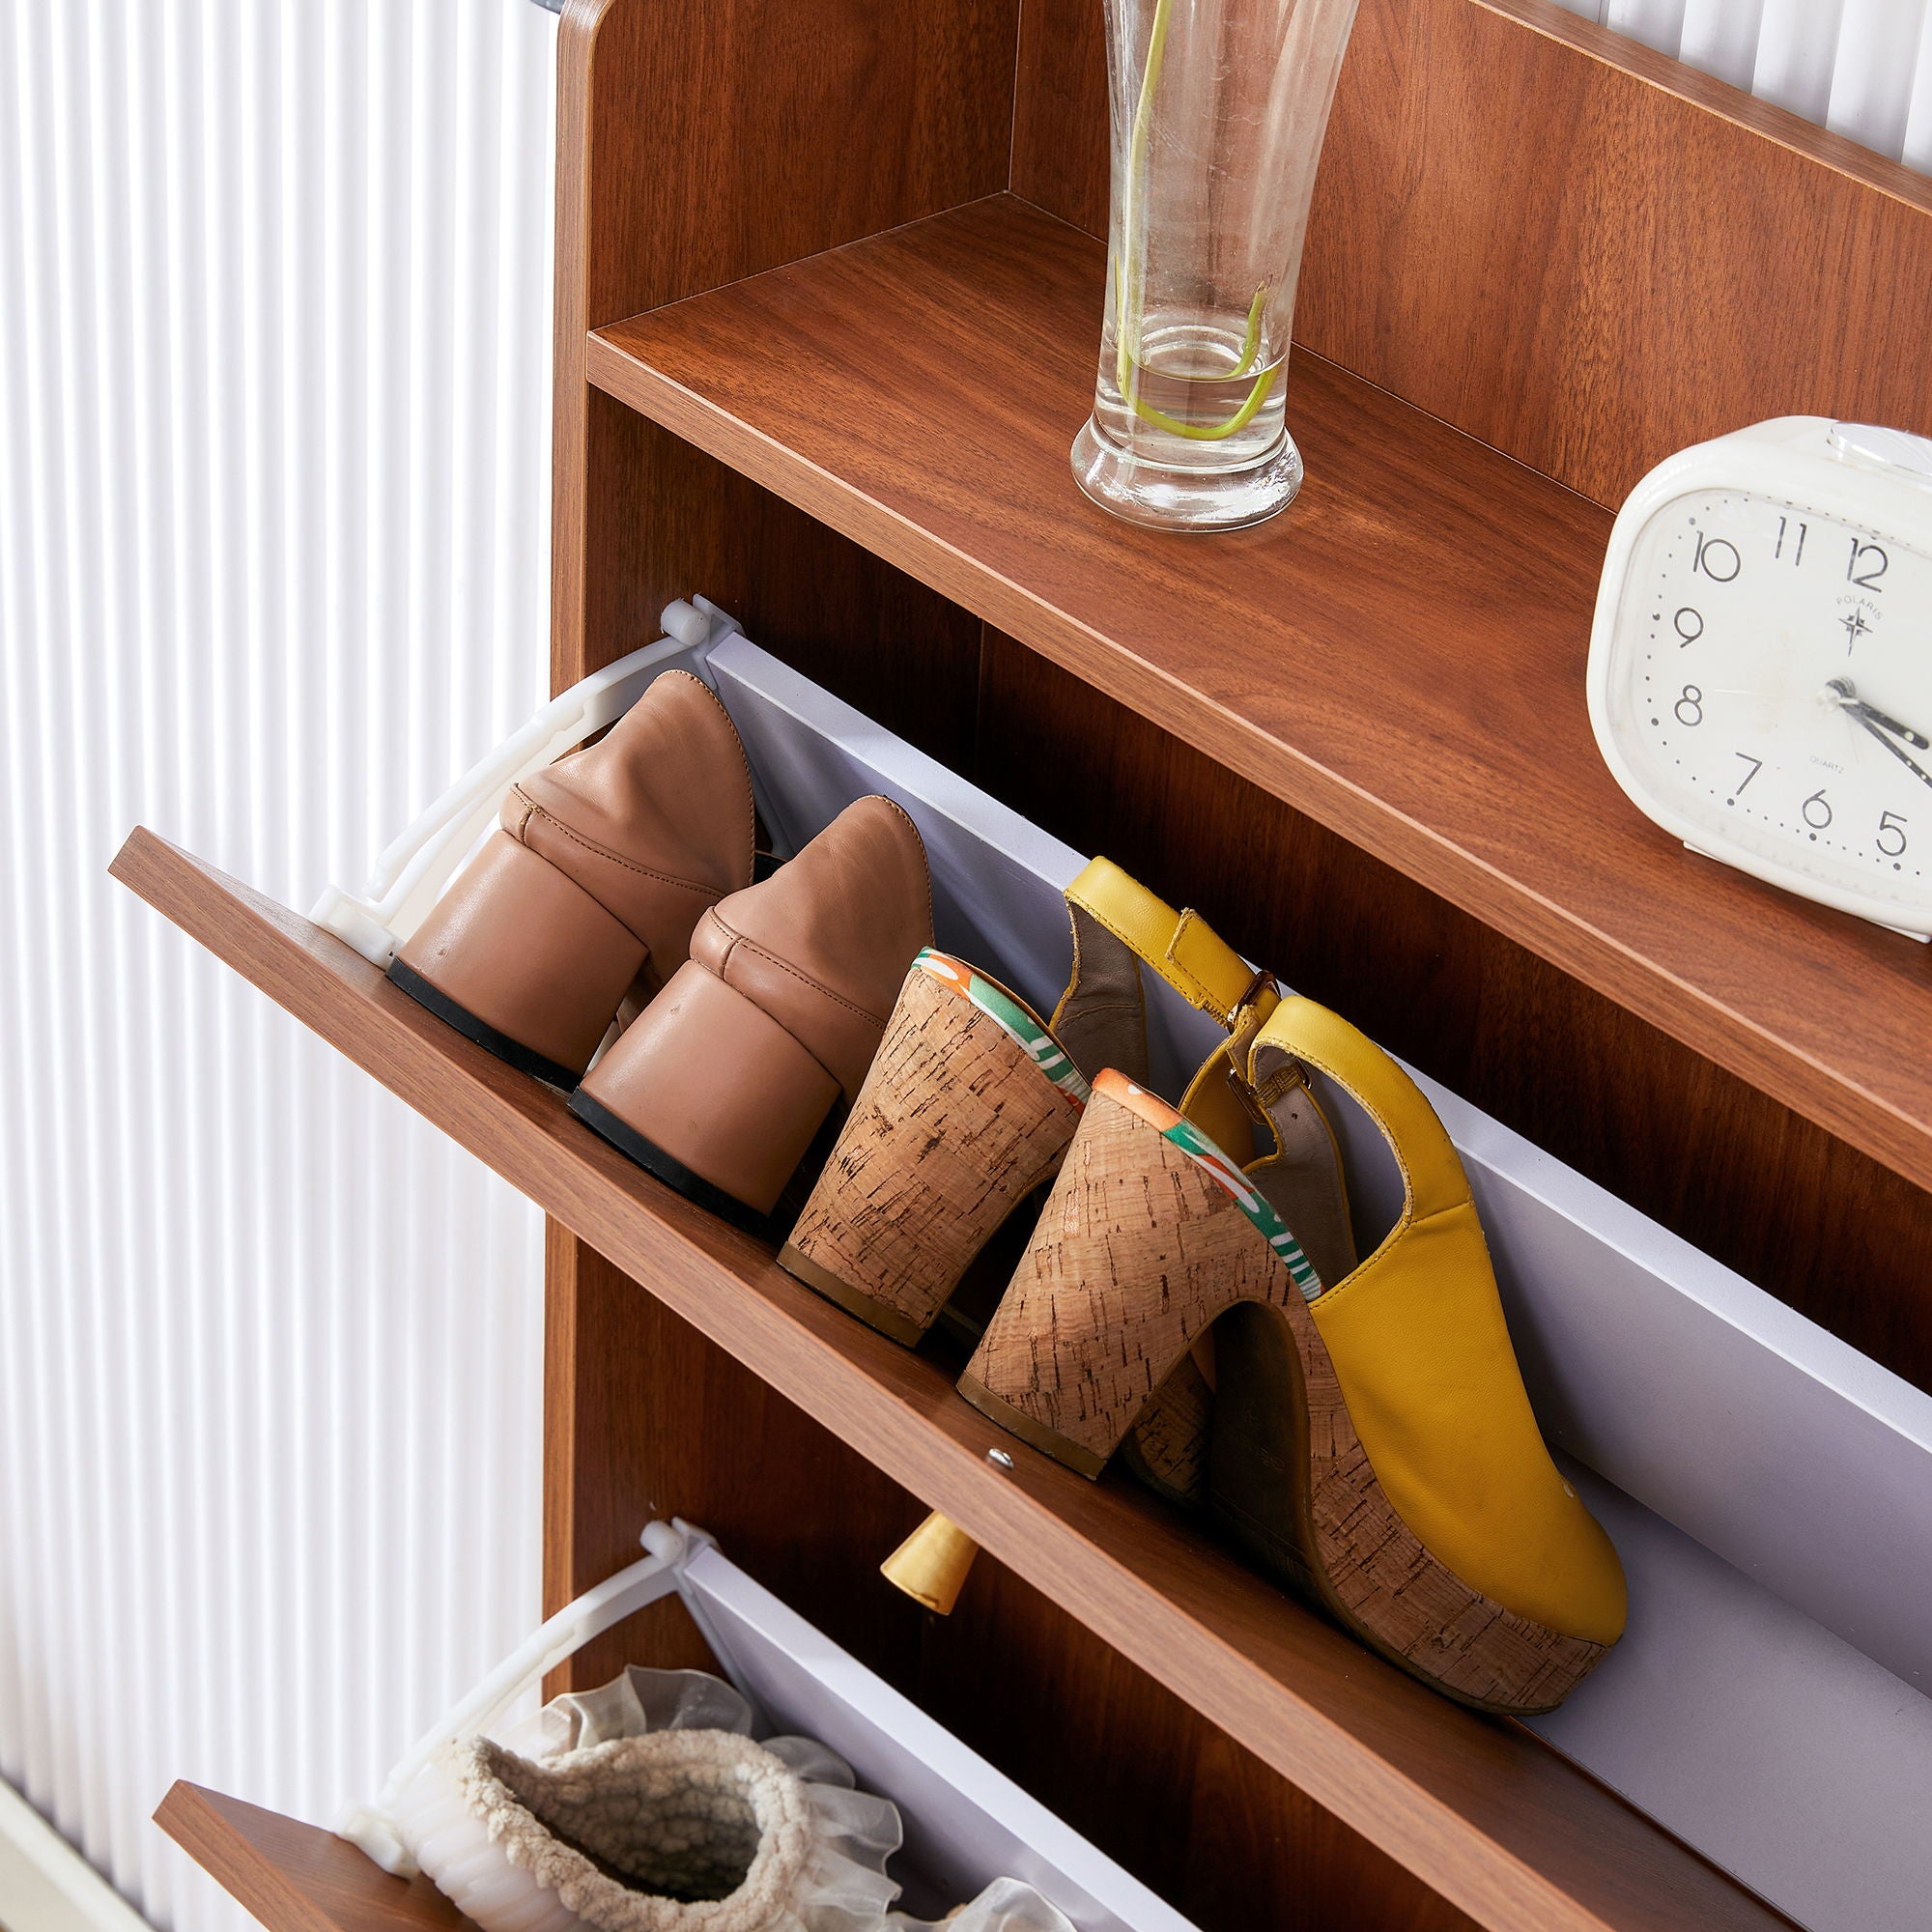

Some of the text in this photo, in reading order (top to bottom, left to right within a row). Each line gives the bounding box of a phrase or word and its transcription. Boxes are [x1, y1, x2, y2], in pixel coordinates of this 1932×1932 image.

[1693, 530, 1741, 582] 10
[1776, 517, 1806, 566] 11
[1847, 538, 1888, 592] 12
[1835, 594, 1883, 619] POLARIS
[1674, 608, 1703, 648] 9
[1674, 685, 1702, 726] 8
[1736, 753, 1762, 795] 7
[1809, 755, 1846, 774] QUARTZ
[1803, 789, 1832, 829] 6
[1876, 810, 1907, 856] 5
